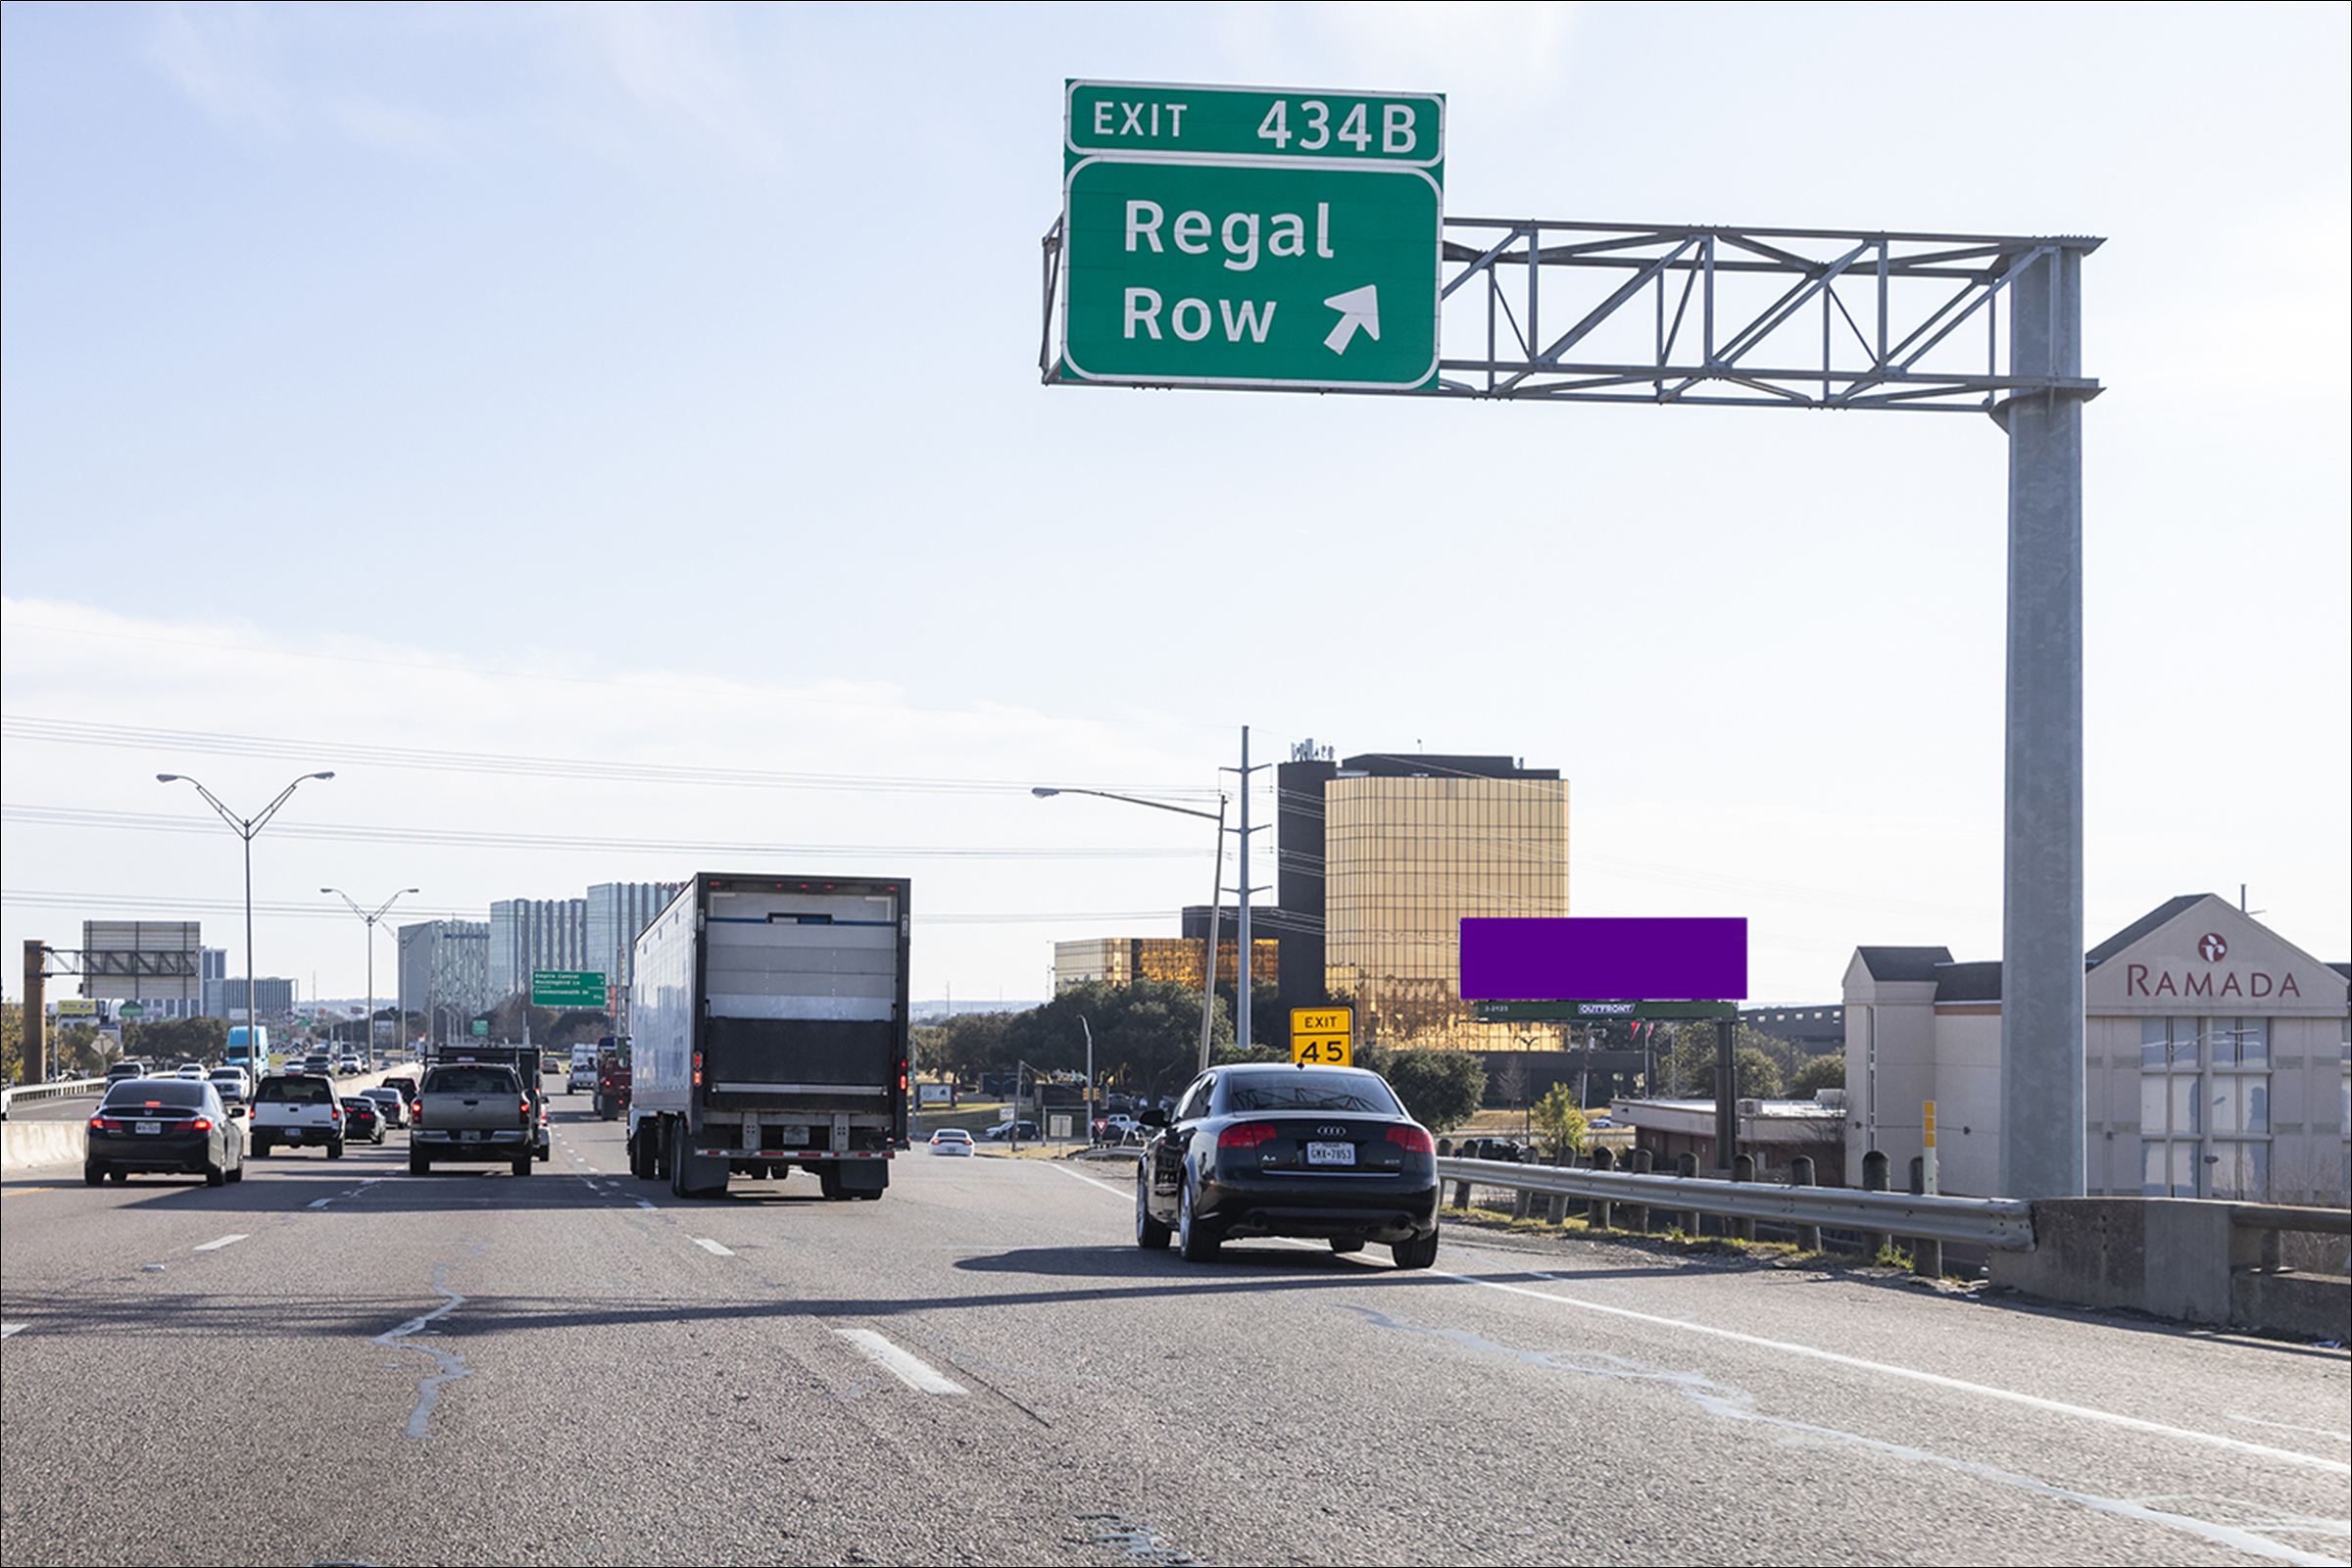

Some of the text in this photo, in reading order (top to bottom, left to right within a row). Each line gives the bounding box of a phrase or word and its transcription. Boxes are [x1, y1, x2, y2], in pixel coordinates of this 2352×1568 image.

[1093, 100, 1417, 154] EXIT 434B
[1124, 199, 1335, 271] Regal
[1123, 286, 1277, 343] Row
[2127, 963, 2301, 998] RAMADA
[1304, 1016, 1338, 1028] EXIT
[1580, 1004, 1633, 1013] OUTFRONT
[1300, 1041, 1344, 1062] 45
